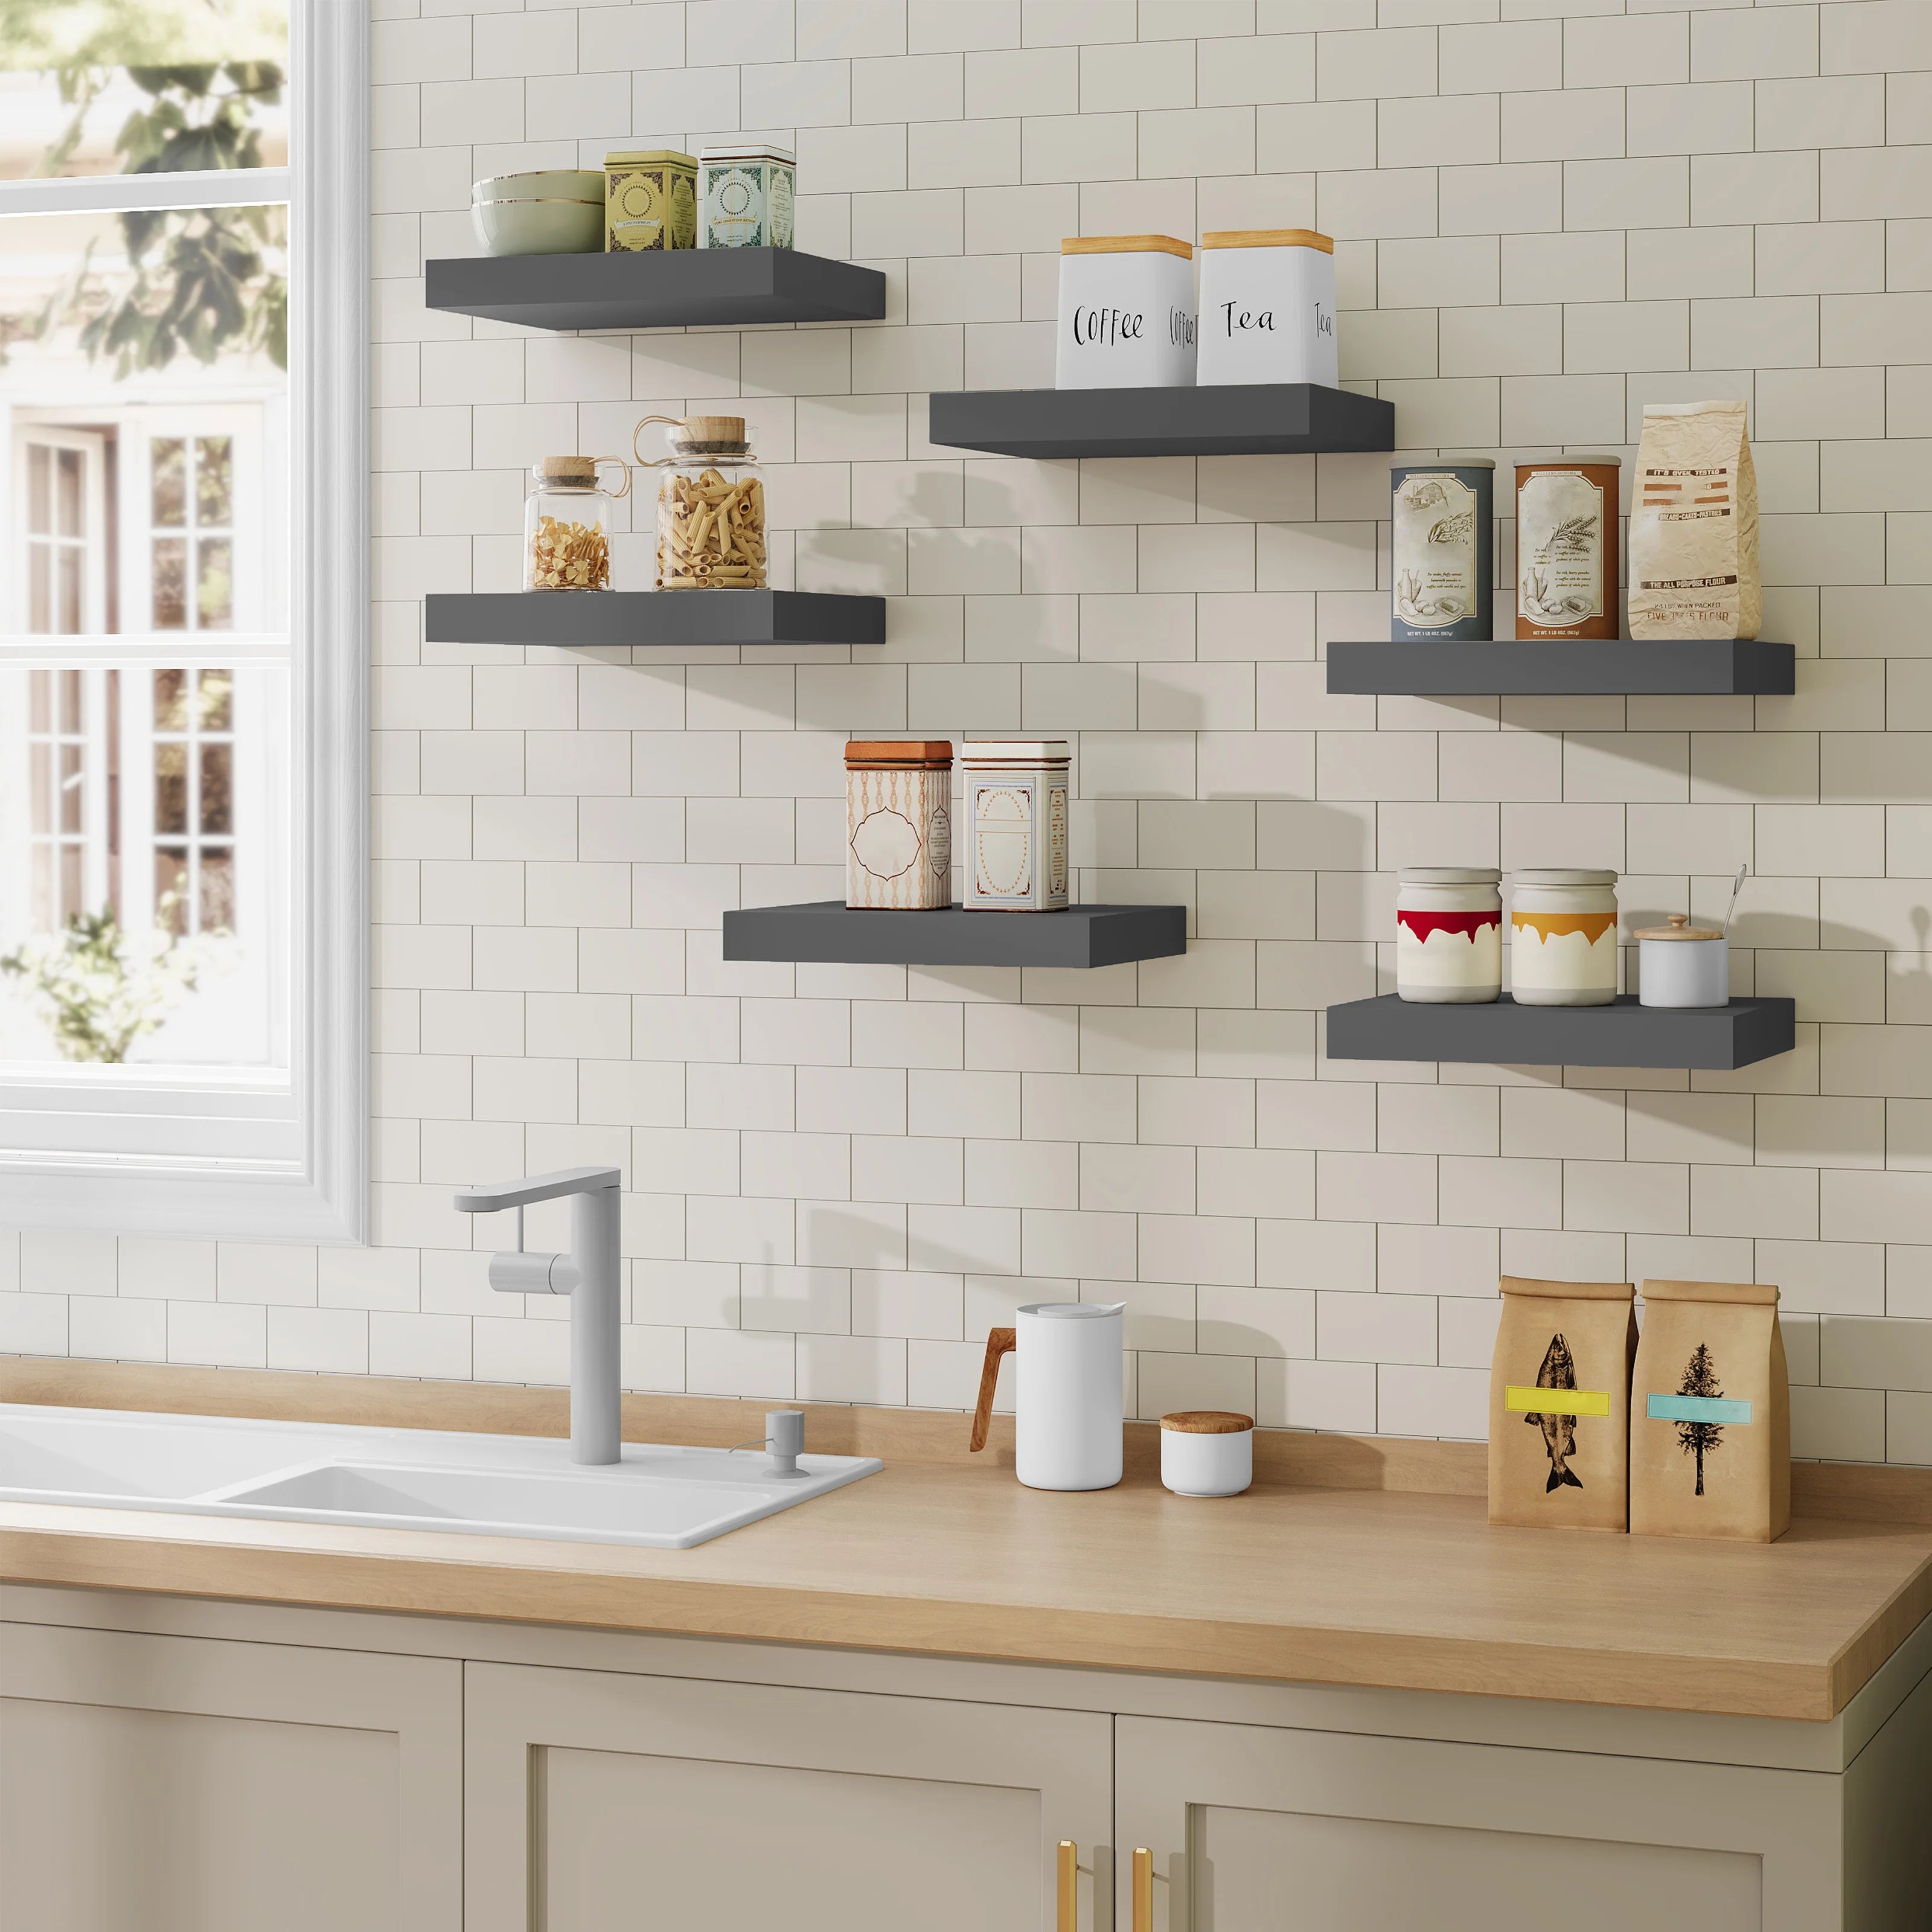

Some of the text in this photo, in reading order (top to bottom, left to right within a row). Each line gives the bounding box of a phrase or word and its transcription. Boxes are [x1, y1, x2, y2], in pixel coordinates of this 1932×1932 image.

[1220, 301, 1277, 337] Tea
[1314, 302, 1332, 337] Tea
[1706, 577, 1726, 586] FLOUR
